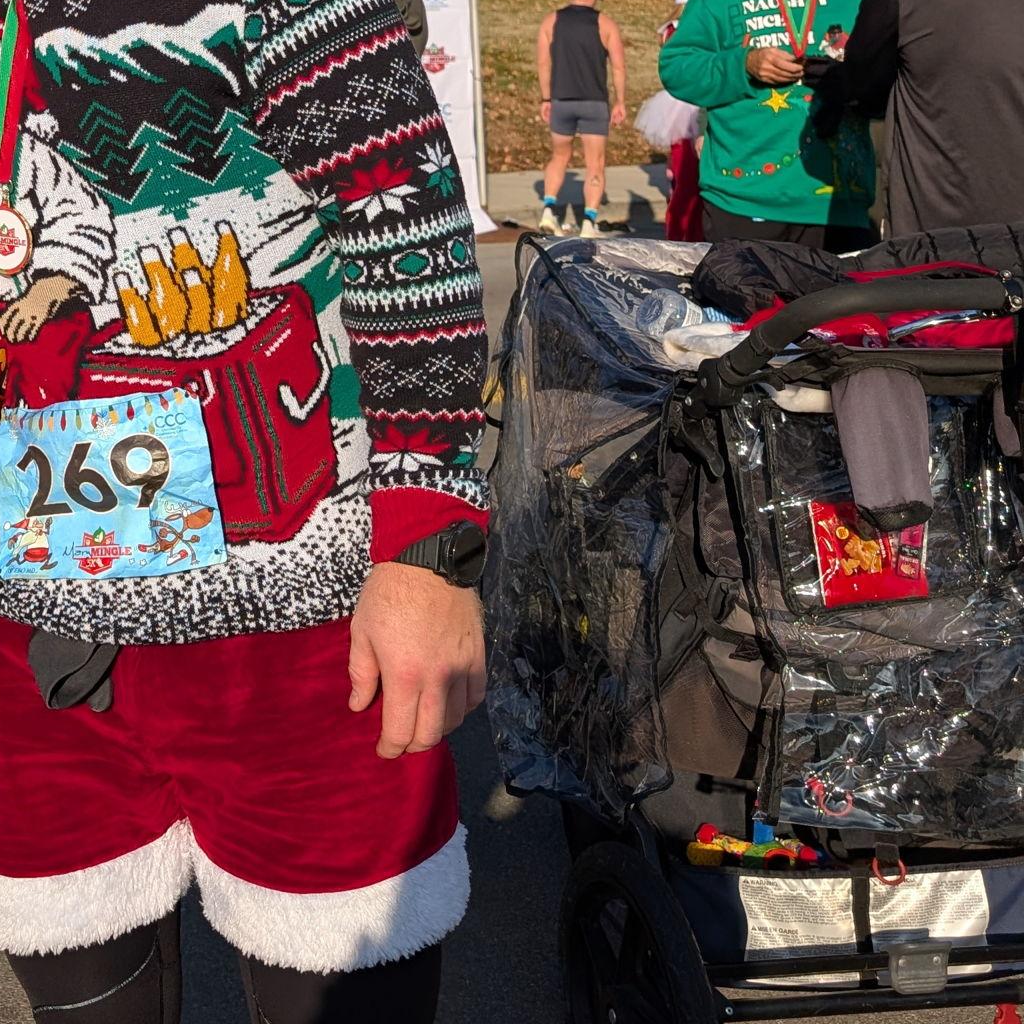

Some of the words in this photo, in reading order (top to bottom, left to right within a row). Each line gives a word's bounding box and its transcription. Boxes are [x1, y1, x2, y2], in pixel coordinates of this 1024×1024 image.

[155, 412, 187, 429] CCC
[16, 434, 171, 518] 269
[90, 546, 132, 557] MINGLE
